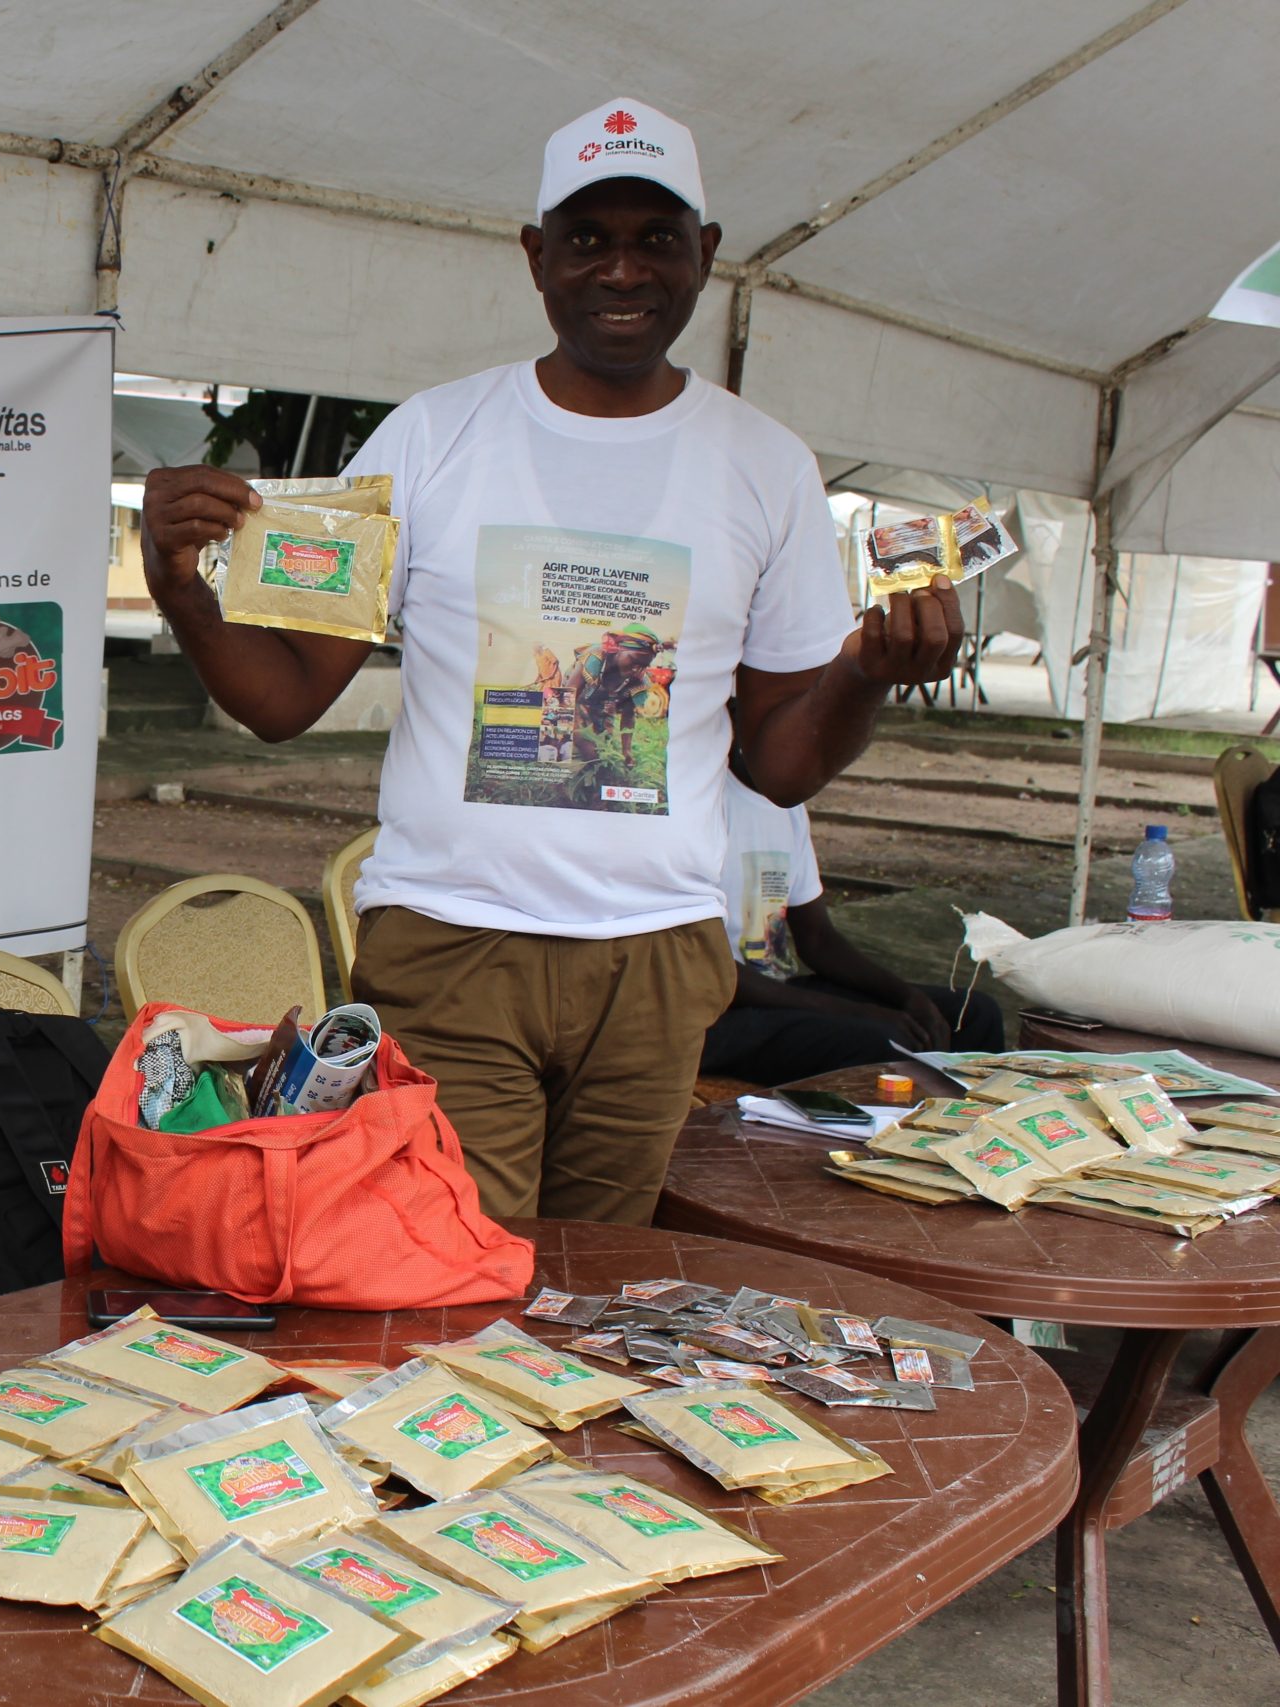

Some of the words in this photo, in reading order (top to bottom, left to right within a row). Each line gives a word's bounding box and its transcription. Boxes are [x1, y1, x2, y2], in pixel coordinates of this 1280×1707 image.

[605, 138, 664, 156] caritas
[28, 570, 50, 586] de
[543, 562, 568, 573] AGIR
[571, 564, 600, 577] POUR
[602, 568, 649, 583] L'AVENIR
[554, 574, 589, 583] ACTEURS
[590, 578, 628, 587] AGRICOLES
[552, 581, 596, 592] OPERATEURS
[597, 586, 646, 598] ECONOMIQUES
[542, 595, 565, 604] SAINS
[567, 597, 577, 605] ET
[578, 598, 590, 606] UN
[591, 599, 619, 609] MONDE
[621, 603, 643, 613] SANS
[644, 607, 662, 617] FAIM
[583, 592, 613, 601] REGIMES
[614, 595, 670, 610] ALIMENTAIRES
[541, 604, 560, 612] DANS
[571, 607, 606, 616] CONTEXTE
[607, 610, 616, 618] DE
